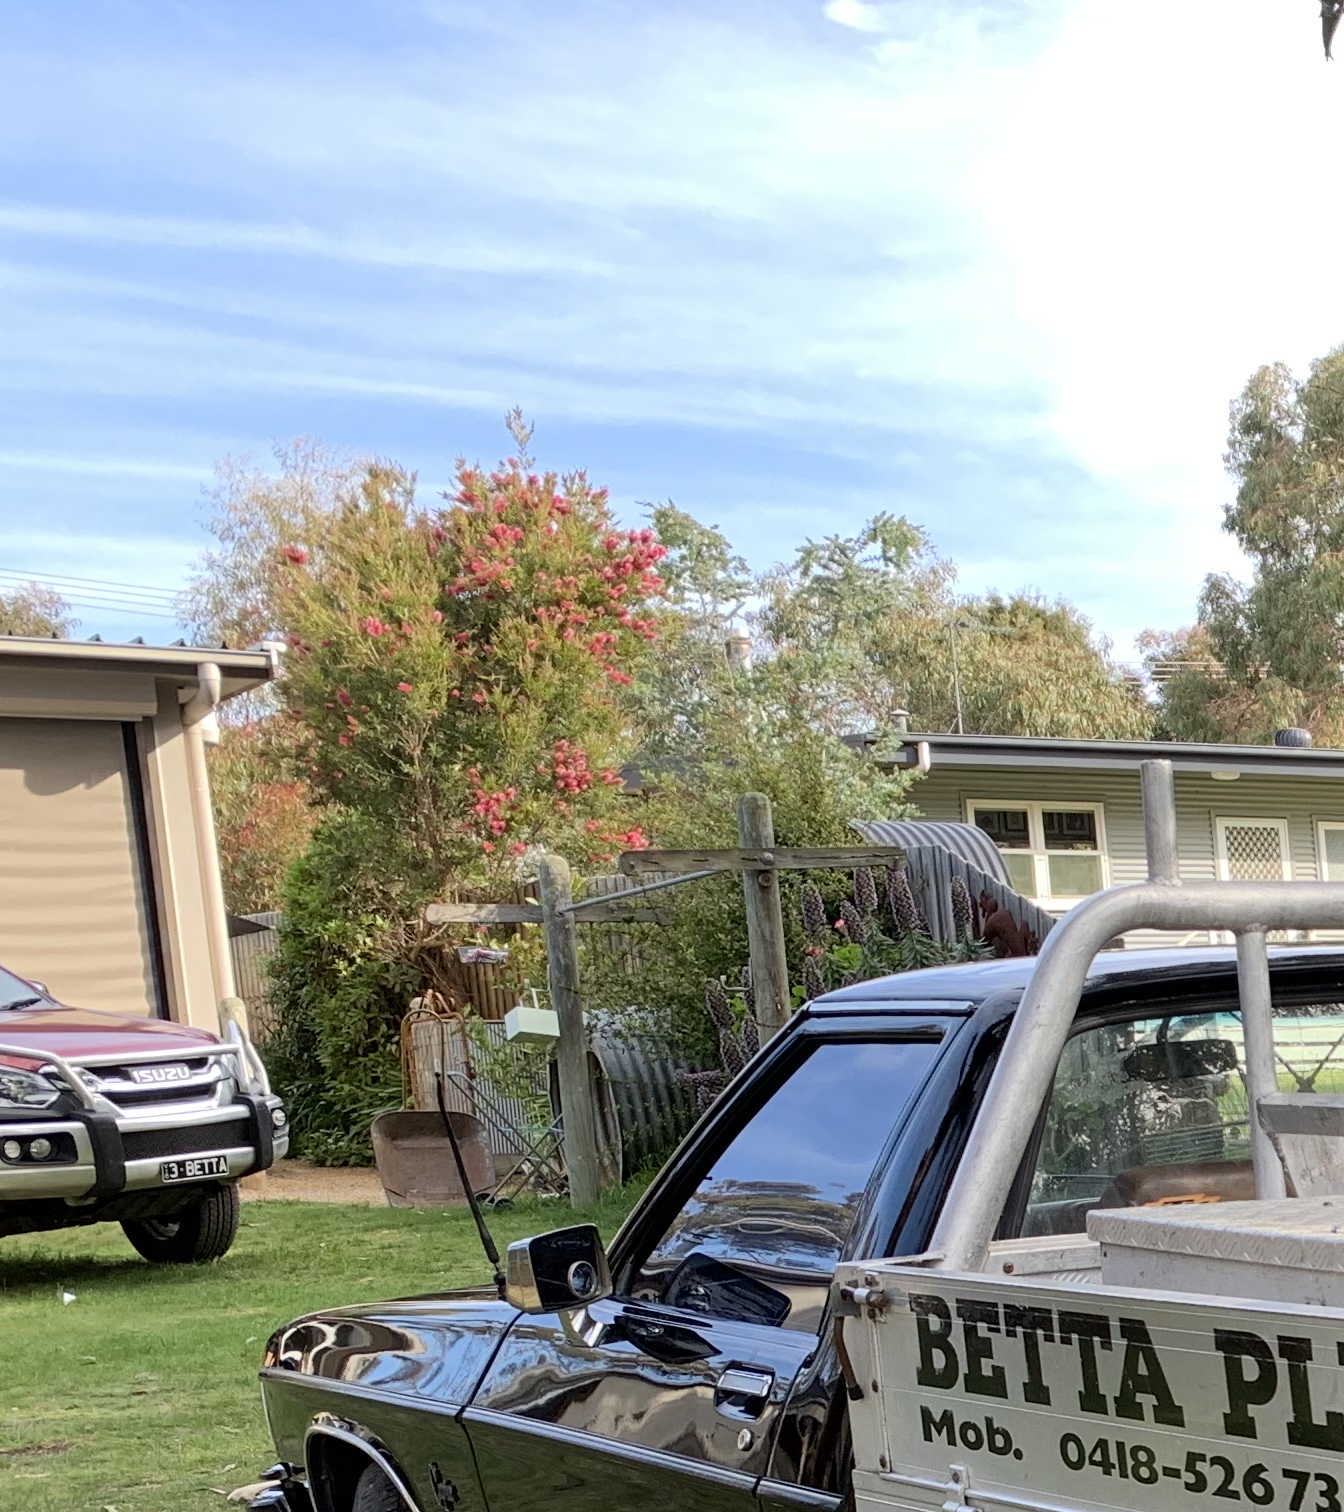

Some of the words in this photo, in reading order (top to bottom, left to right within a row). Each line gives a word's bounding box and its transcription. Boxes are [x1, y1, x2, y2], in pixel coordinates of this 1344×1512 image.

[132, 1066, 190, 1083] ISUZU
[908, 1291, 1186, 1429] BETTA
[919, 1404, 1025, 1461] Mob.
